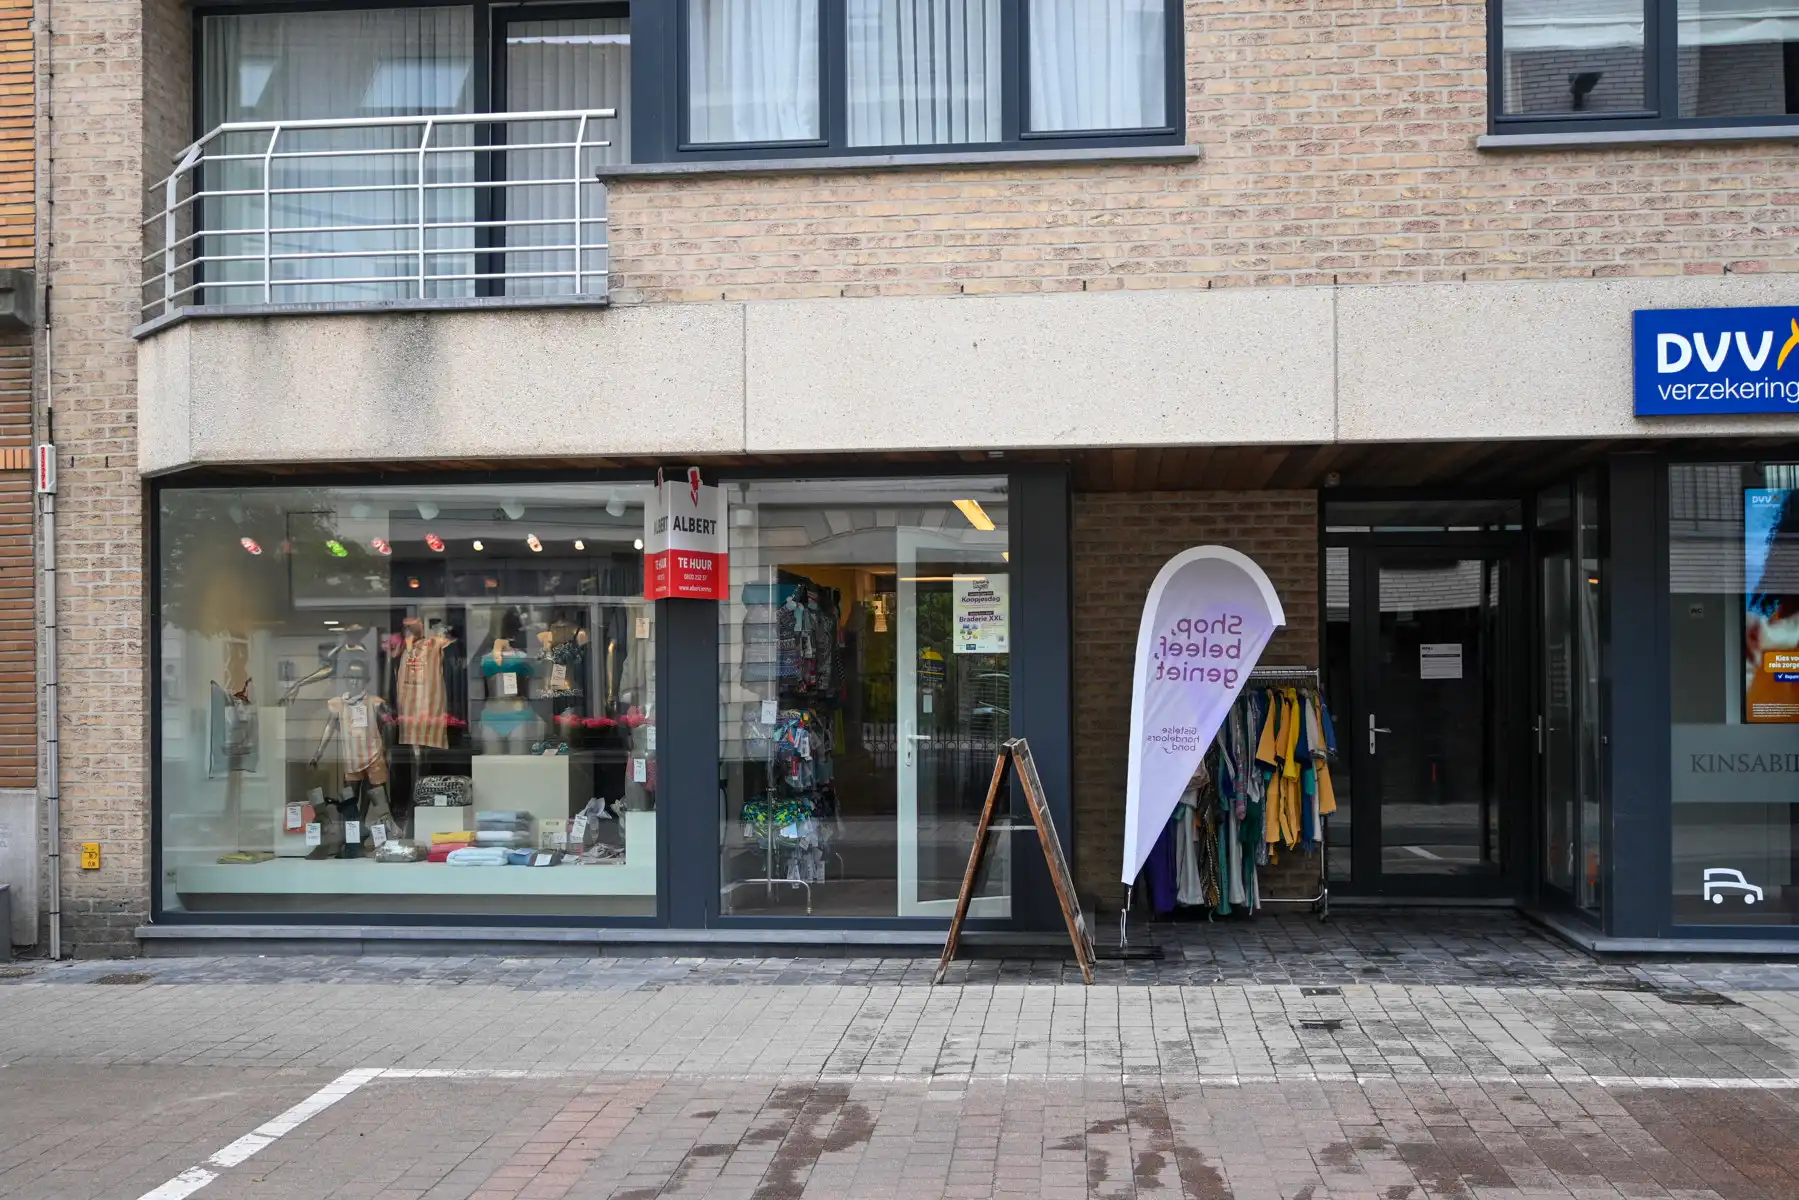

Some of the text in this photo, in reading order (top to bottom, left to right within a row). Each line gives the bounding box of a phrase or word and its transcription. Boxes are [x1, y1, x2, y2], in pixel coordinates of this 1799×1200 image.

[1657, 331, 1774, 373] DVV
[1658, 377, 1799, 403] verzekering
[1752, 495, 1772, 503] DVV
[673, 516, 717, 535] ALBERT
[678, 557, 713, 571] TE HUUR
[961, 595, 1000, 603] Koopjesdag
[959, 615, 987, 623] Braderie
